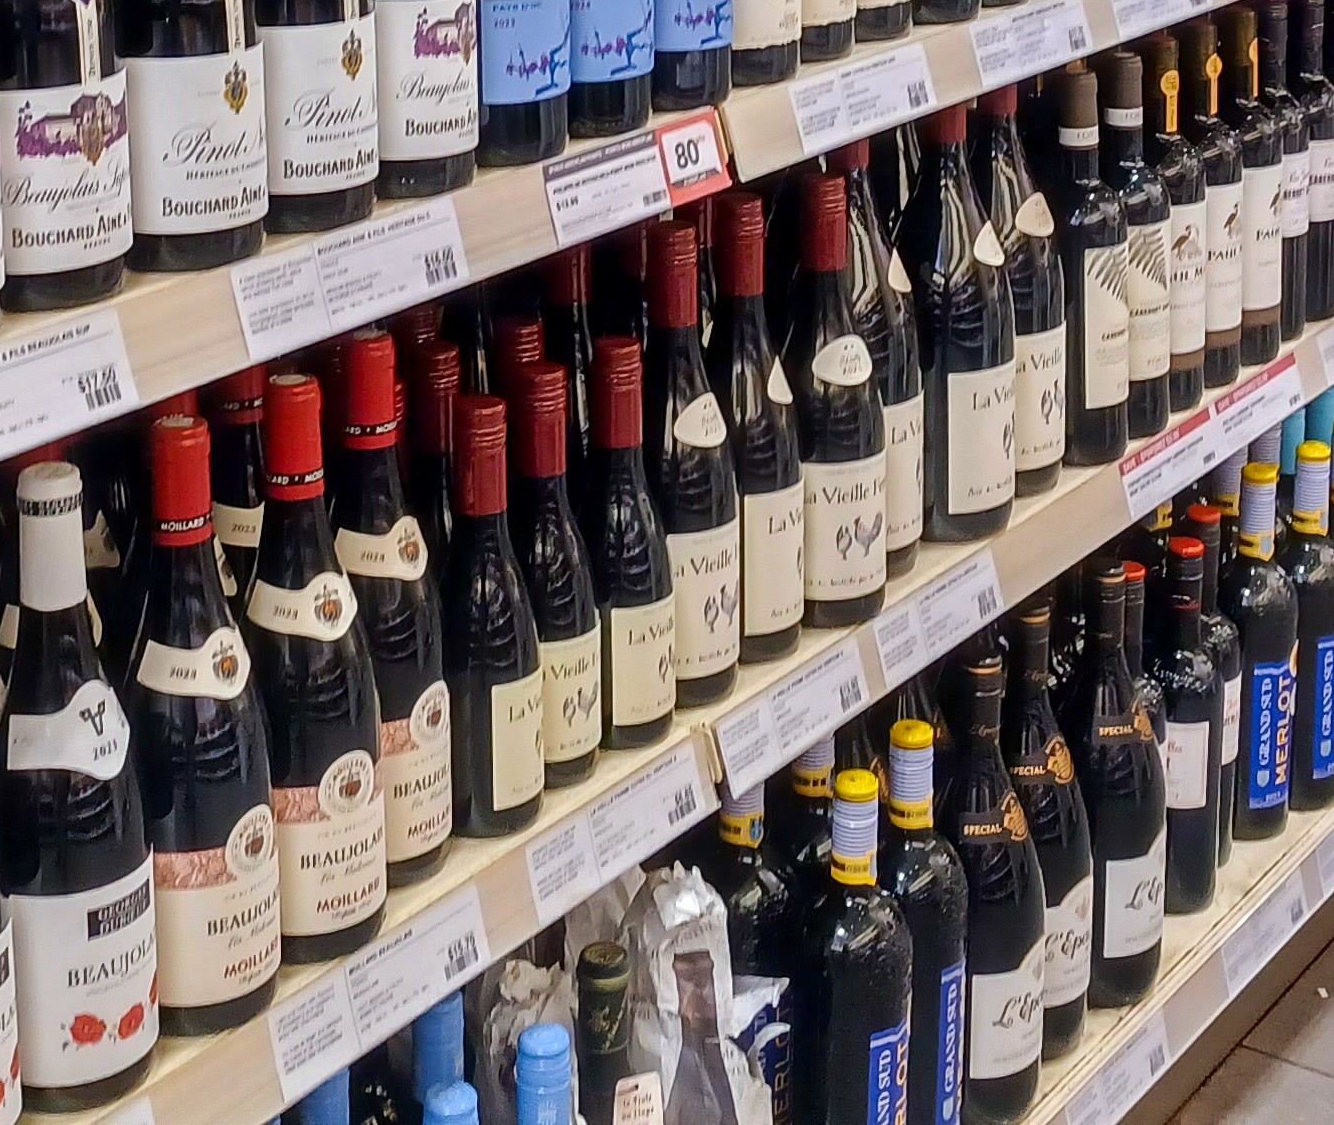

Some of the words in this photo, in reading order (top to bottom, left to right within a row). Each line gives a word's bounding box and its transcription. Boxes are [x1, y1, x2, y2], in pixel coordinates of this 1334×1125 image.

[284, 87, 363, 134] Pinot
[405, 116, 466, 137] BOUCHARD
[163, 118, 248, 167] Pinot
[675, 139, 699, 169] 80
[283, 157, 355, 180] BOUCHARD
[4, 173, 99, 210] Beaujolais
[162, 194, 240, 217] BOUCHARD
[11, 226, 95, 249] BOUCHARD
[972, 391, 992, 412] La
[822, 483, 866, 506] Vieille
[161, 519, 204, 530] MOILLARD
[1323, 650, 1334, 682] SUD
[1261, 677, 1272, 709] SUD
[1322, 683, 1333, 737] GRAND
[1098, 724, 1134, 737] SPECIAL
[1259, 711, 1271, 766] GRAND
[1275, 676, 1291, 785] MERLOT
[963, 823, 1003, 836] SPECIAL
[316, 878, 380, 915] MOILLARD
[878, 1048, 892, 1088] SUD
[944, 1028, 957, 1093] GRAND
